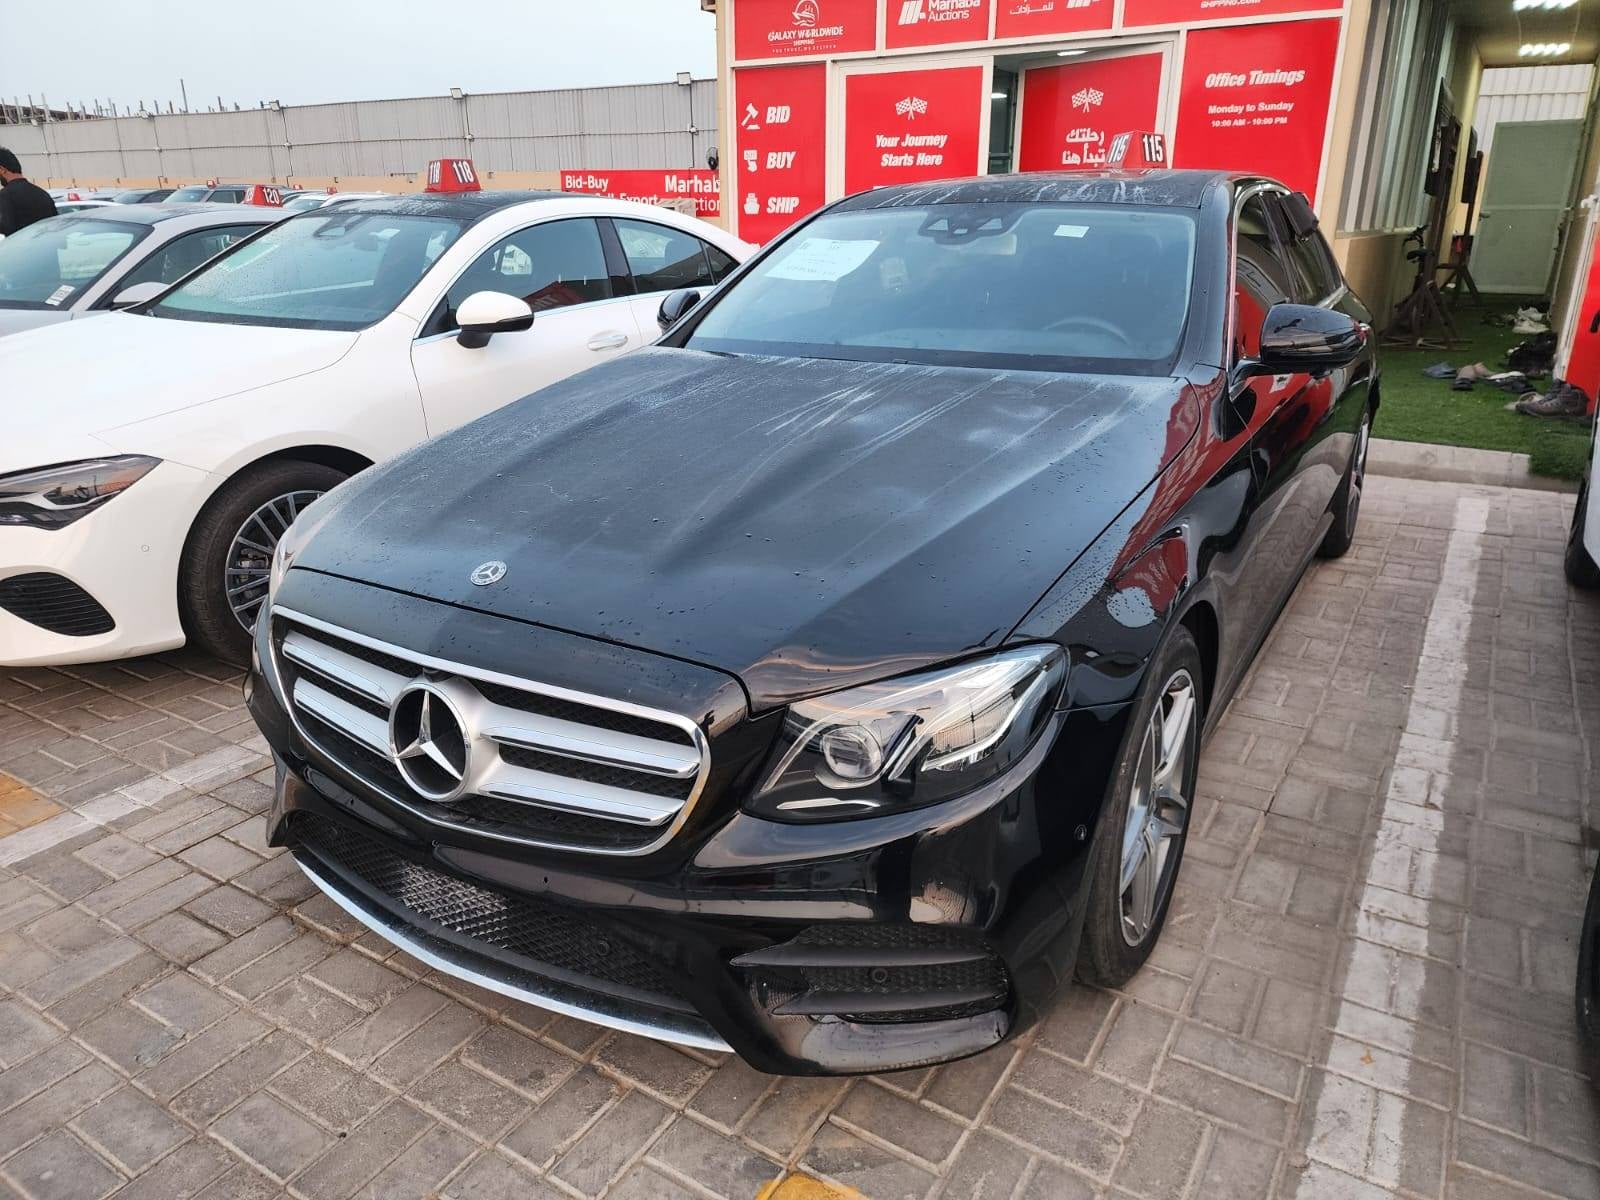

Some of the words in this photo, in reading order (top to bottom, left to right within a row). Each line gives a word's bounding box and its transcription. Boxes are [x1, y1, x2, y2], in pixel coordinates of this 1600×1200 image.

[928, 10, 970, 22] Auctions
[767, 30, 797, 41] GALAXY
[1205, 72, 1246, 88] Office
[1249, 69, 1305, 86] Timings
[766, 105, 791, 124] BID
[1208, 103, 1244, 115] Monday
[1246, 103, 1256, 112] to
[1257, 101, 1294, 112] Sunday
[1211, 119, 1232, 127] 10:00
[1232, 118, 1246, 126] AM
[1274, 116, 1288, 124] PM
[876, 134, 900, 148] Your
[901, 133, 948, 149] Journey
[1065, 127, 1105, 146] رحلتك
[1142, 134, 1164, 163] 115
[766, 151, 796, 169] BUY
[881, 153, 914, 167] Starts
[916, 152, 943, 166] Here
[1061, 150, 1081, 165] هنا
[452, 160, 475, 183] 118
[565, 175, 609, 191] Bid-Buy
[263, 187, 280, 204] 120
[766, 196, 800, 214] SHIP
